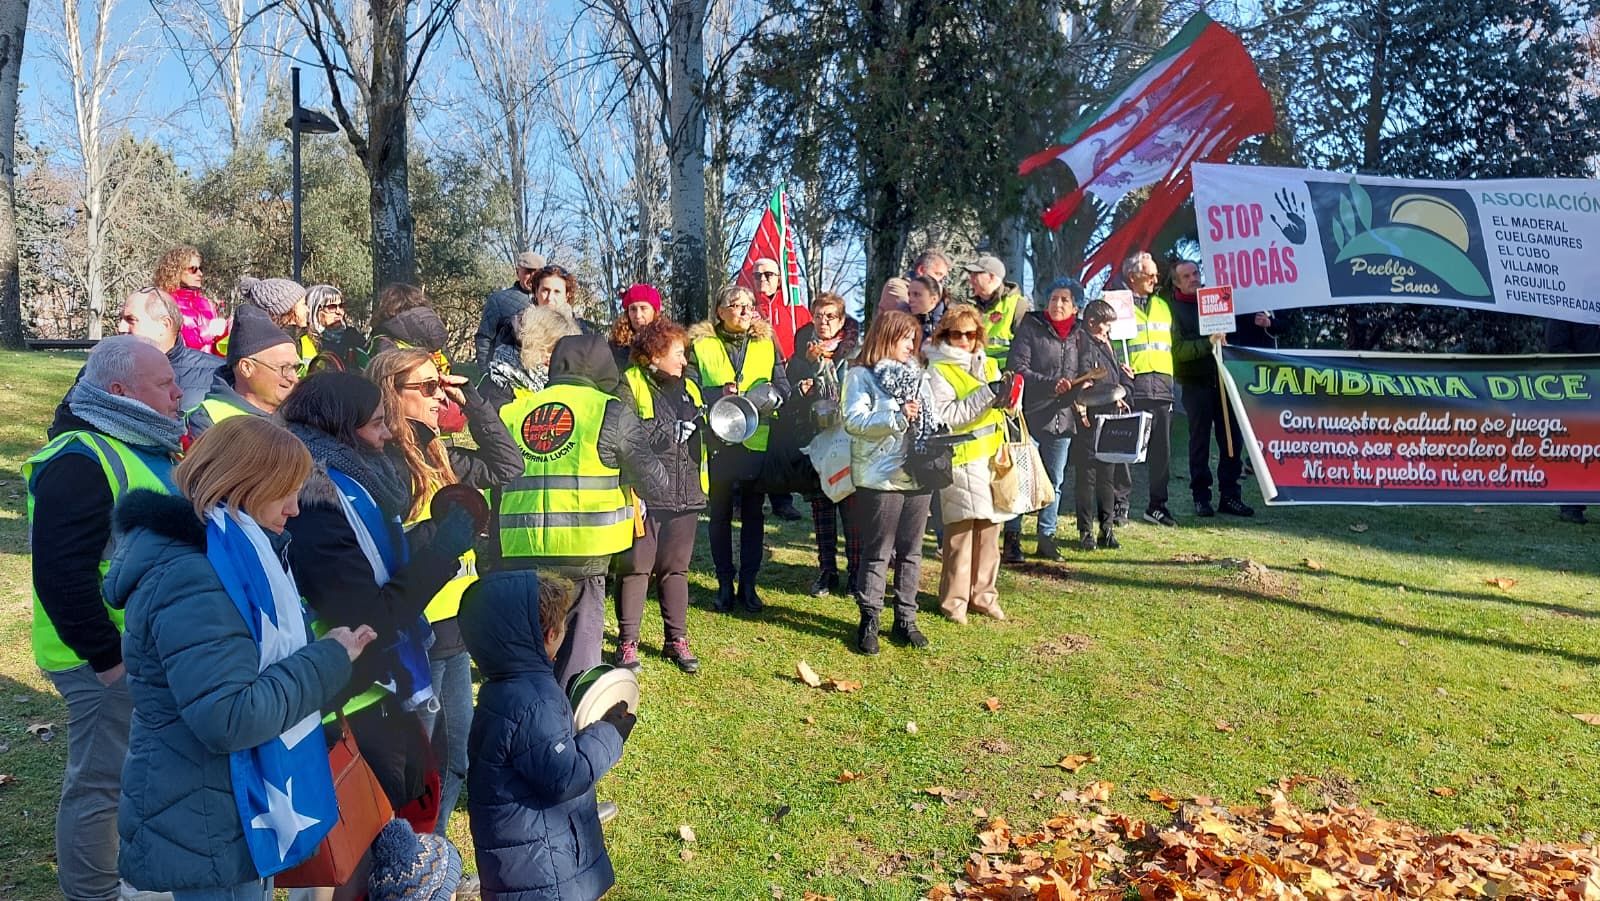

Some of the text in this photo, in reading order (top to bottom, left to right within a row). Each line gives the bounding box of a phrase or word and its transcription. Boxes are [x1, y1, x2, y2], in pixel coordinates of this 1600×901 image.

[1207, 203, 1263, 242] STOP
[1492, 215, 1568, 233] EL MADERAL
[1495, 230, 1583, 250] CUELGAMURES
[1498, 245, 1550, 259] EL CUBO
[1213, 240, 1298, 289] BIOGÁS
[1350, 257, 1416, 276] Pueblos
[1500, 259, 1559, 276] VILLAMOR
[1390, 275, 1440, 294] Sanos
[1504, 274, 1566, 292] ARGUJILLO
[1202, 294, 1219, 305] STOP
[1506, 289, 1600, 313] FUENTESPREADAS
[1248, 366, 1592, 400] JAMBRINA DICE
[1280, 410, 1568, 438] Con nuestra salud no se juega.
[550, 441, 576, 461] LUCHA
[1268, 439, 1359, 460] queremos
[1361, 441, 1393, 456] ser
[1396, 437, 1507, 458] estercolero
[1511, 438, 1537, 457] de
[1302, 460, 1546, 486] Ni en tu pueblo ni en el mío
